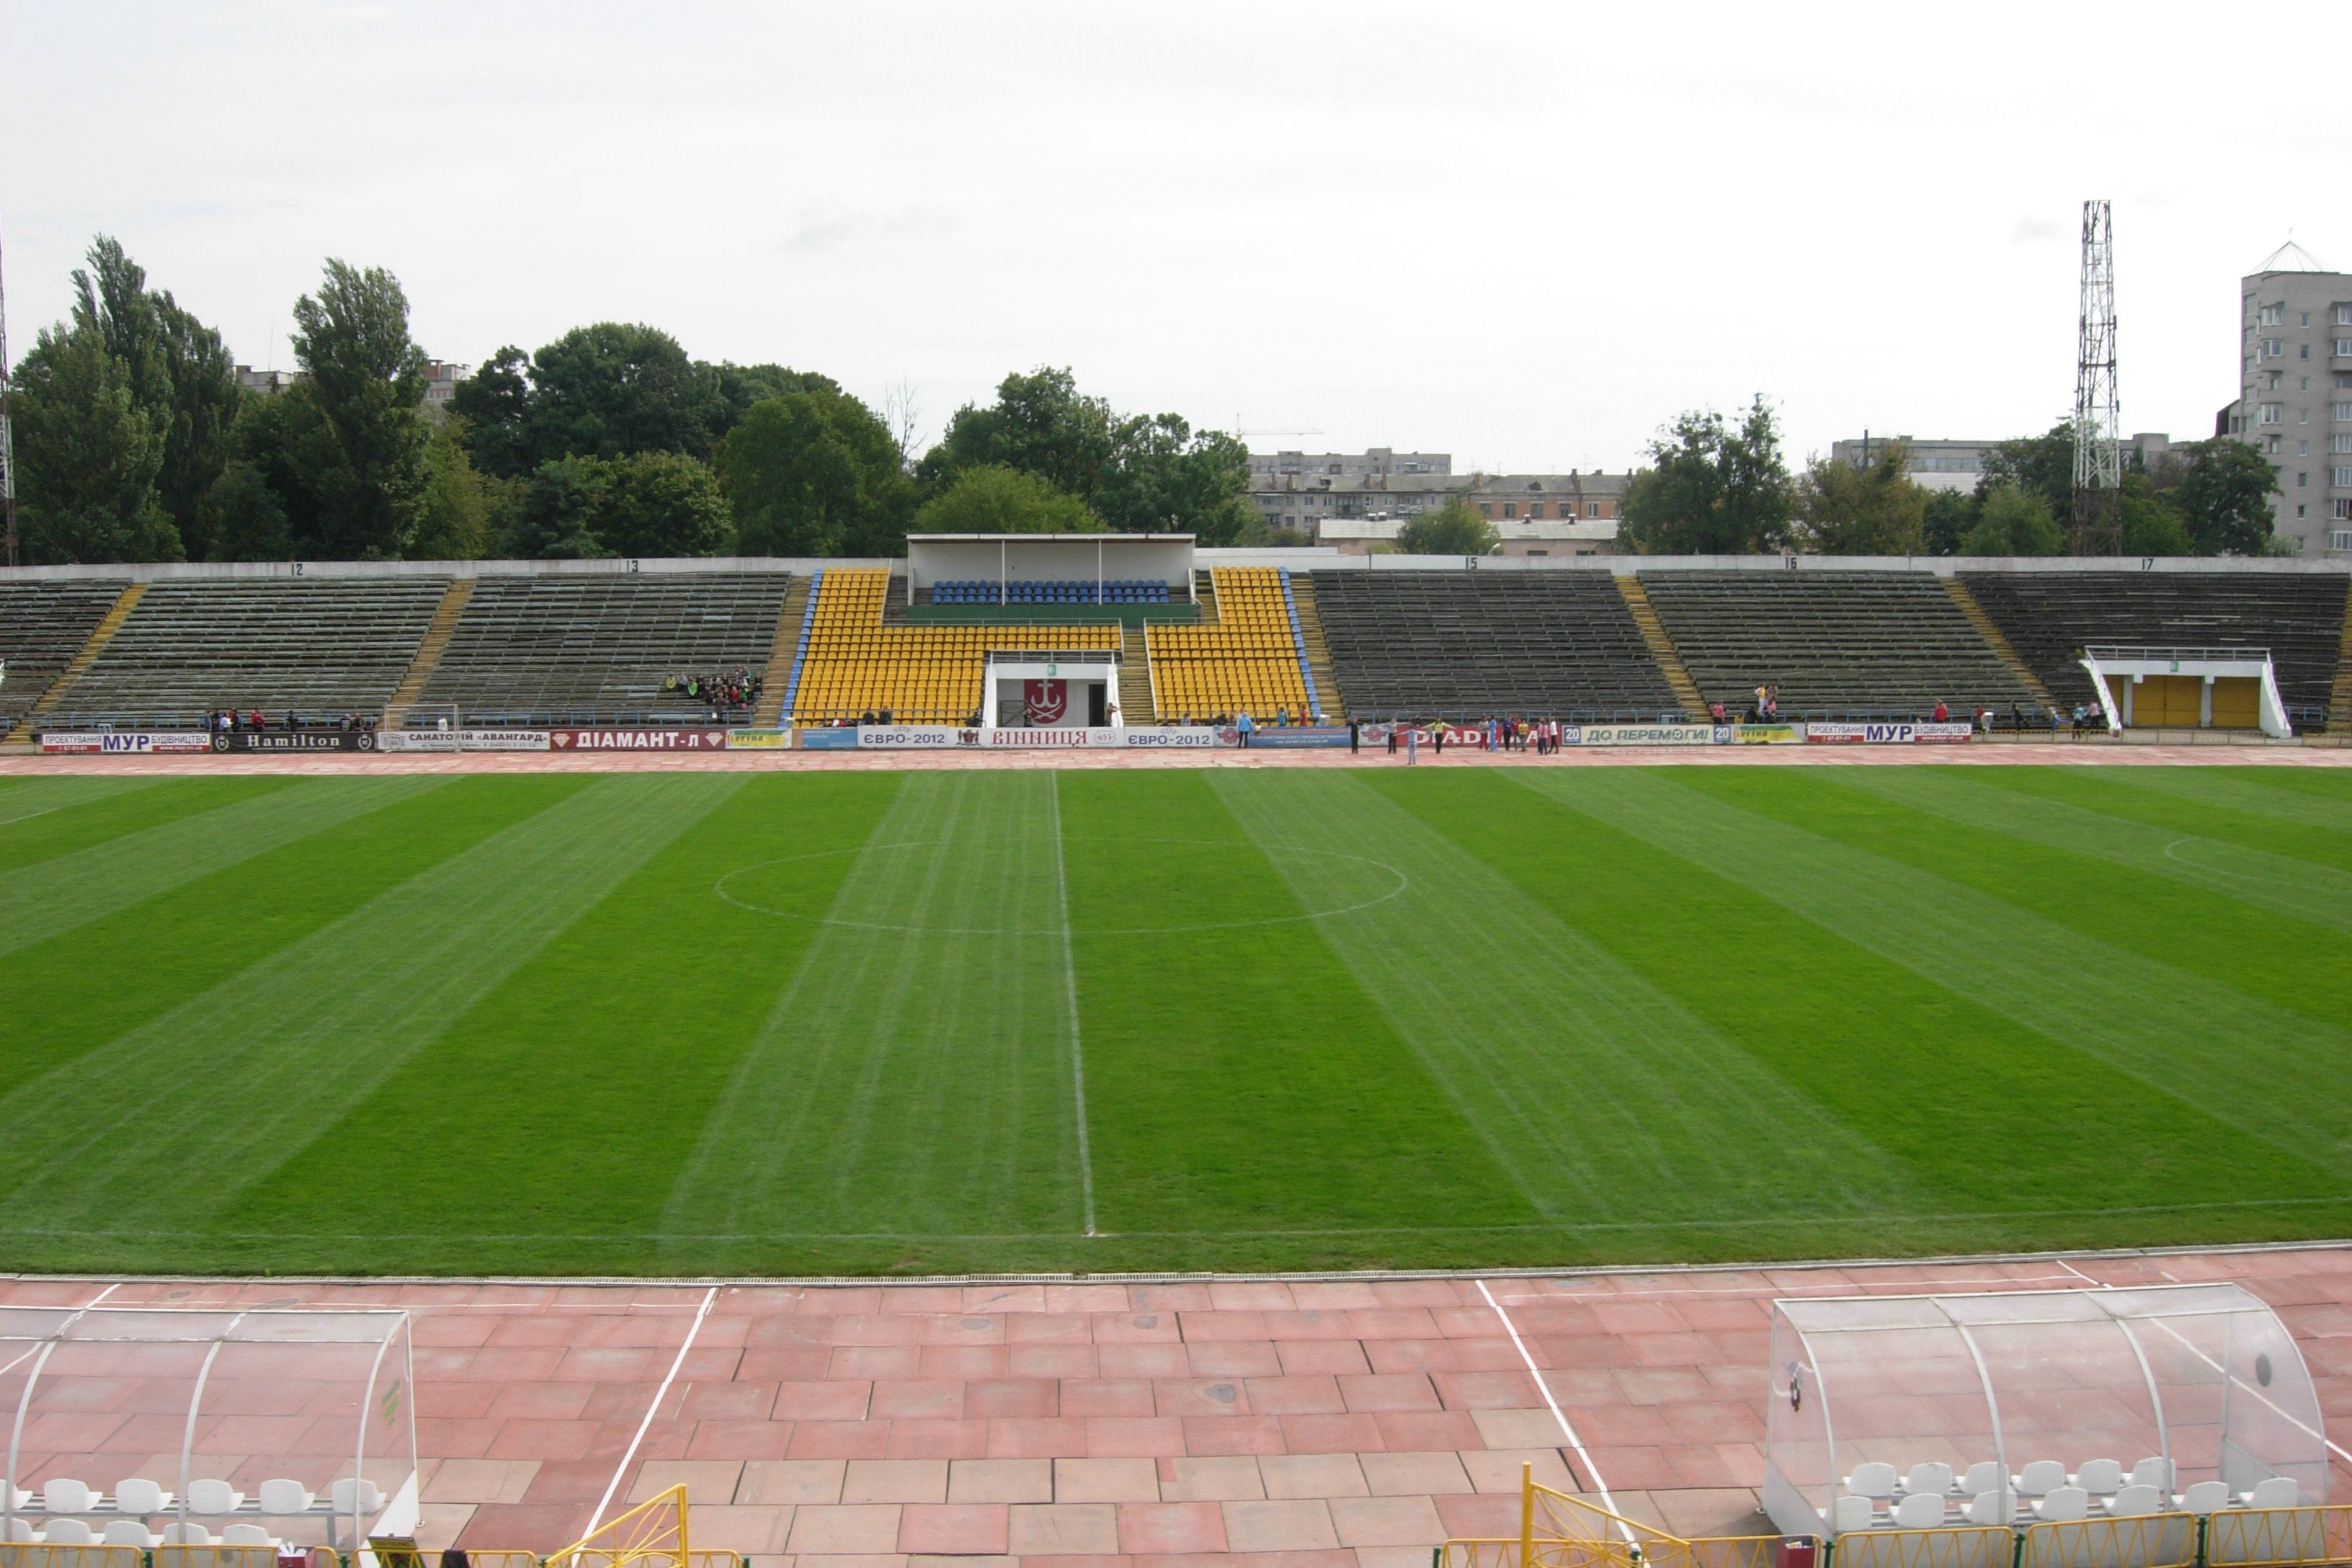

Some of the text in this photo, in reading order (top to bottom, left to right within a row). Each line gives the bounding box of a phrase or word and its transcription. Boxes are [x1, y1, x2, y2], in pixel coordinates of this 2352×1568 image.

[626, 560, 638, 572] 13
[1466, 557, 1477, 569] 15
[1786, 557, 1796, 569] 16
[2142, 558, 2154, 570] 17
[291, 564, 303, 576] 12
[864, 734, 945, 744] ЄВРО-2012
[993, 731, 1087, 747] ВІННИЦЯ
[1566, 729, 1580, 740] 20
[1587, 730, 1612, 742] ДО
[1716, 727, 1729, 739] 20
[1866, 726, 1912, 740] МУР
[104, 736, 149, 750] МУР
[247, 735, 339, 747] Hamilton
[1128, 735, 1210, 744] ЄВРО-2012
